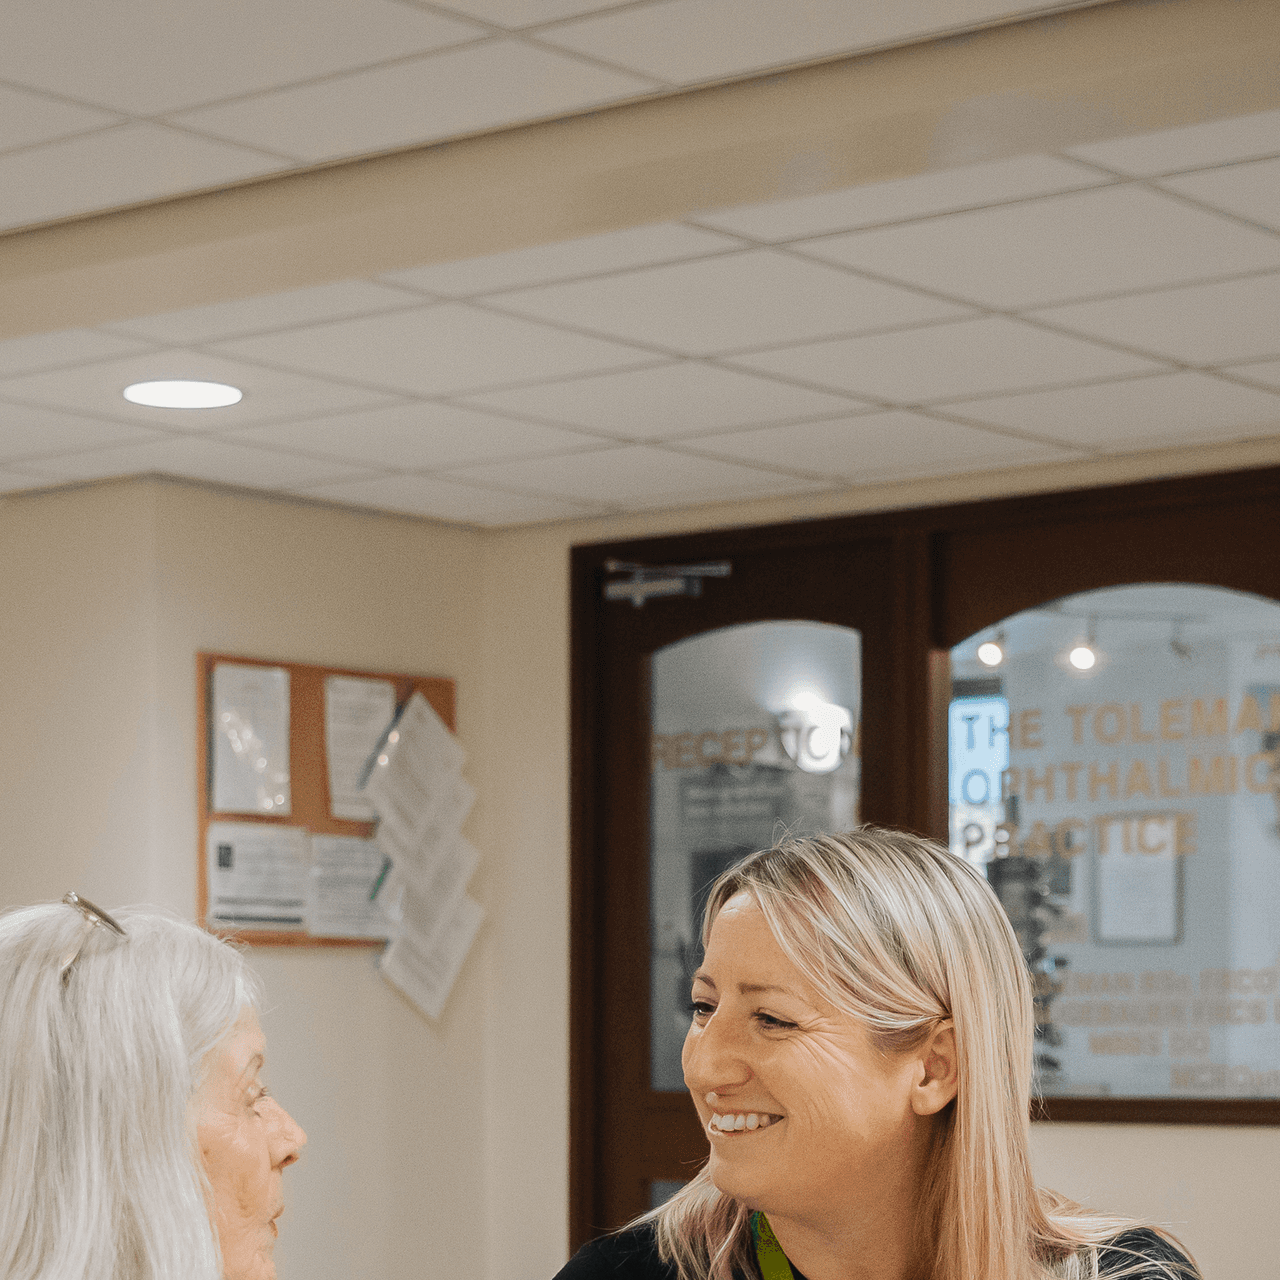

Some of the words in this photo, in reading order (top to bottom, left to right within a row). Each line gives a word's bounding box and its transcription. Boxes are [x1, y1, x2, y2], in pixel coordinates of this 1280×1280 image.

[961, 708, 1043, 750] THE
[961, 752, 1275, 804] OPHTHALMIC
[965, 811, 1199, 858] PRACTICE
